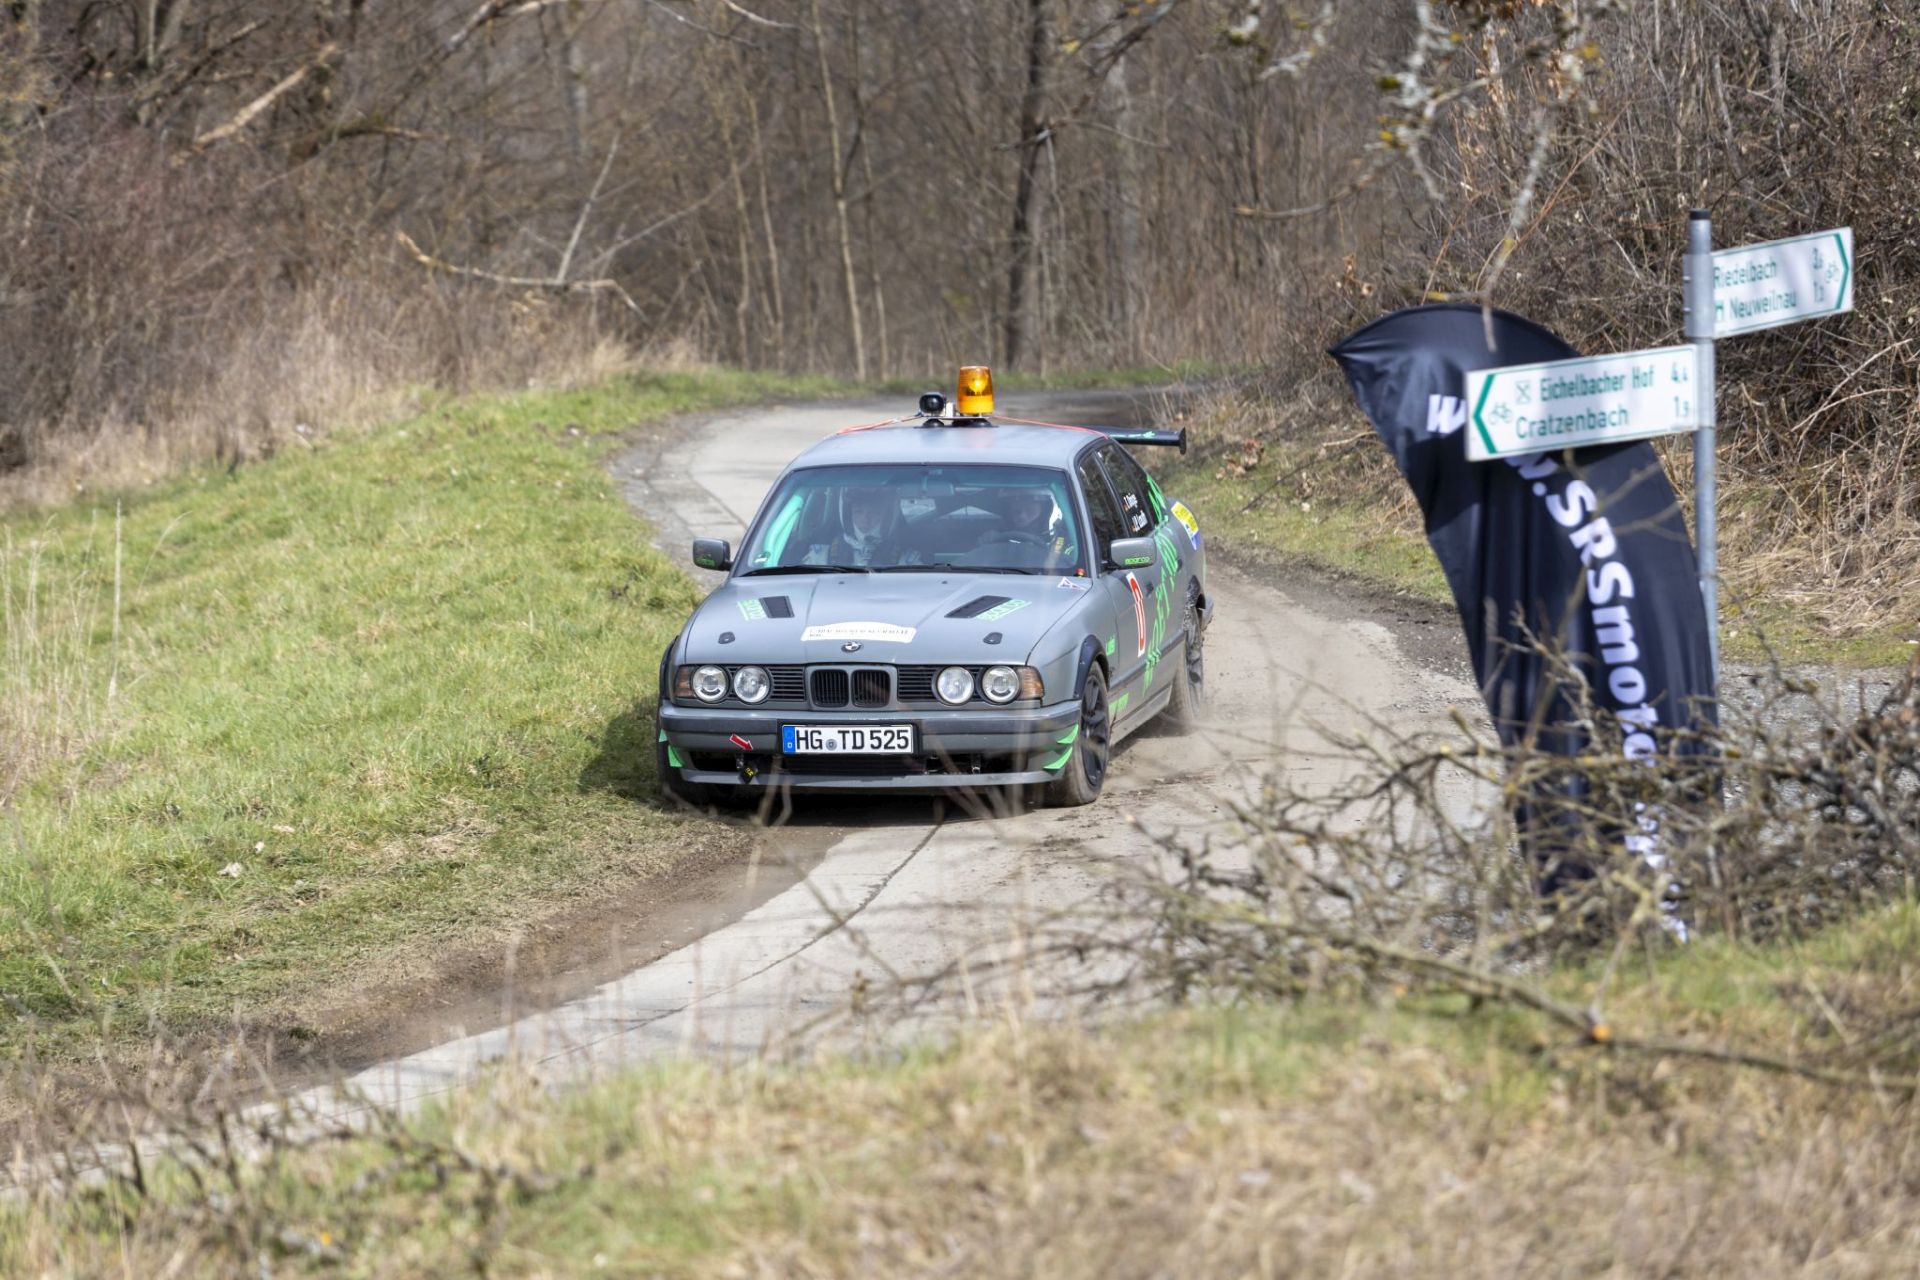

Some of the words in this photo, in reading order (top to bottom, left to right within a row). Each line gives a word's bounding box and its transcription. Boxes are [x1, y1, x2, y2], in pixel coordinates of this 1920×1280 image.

[1539, 372, 1626, 402] Eichelbacher
[1632, 364, 1654, 389] Hof
[1515, 406, 1628, 439] Cratzenbach
[796, 729, 823, 750] HG
[838, 729, 865, 750] TD
[870, 729, 909, 750] 525
